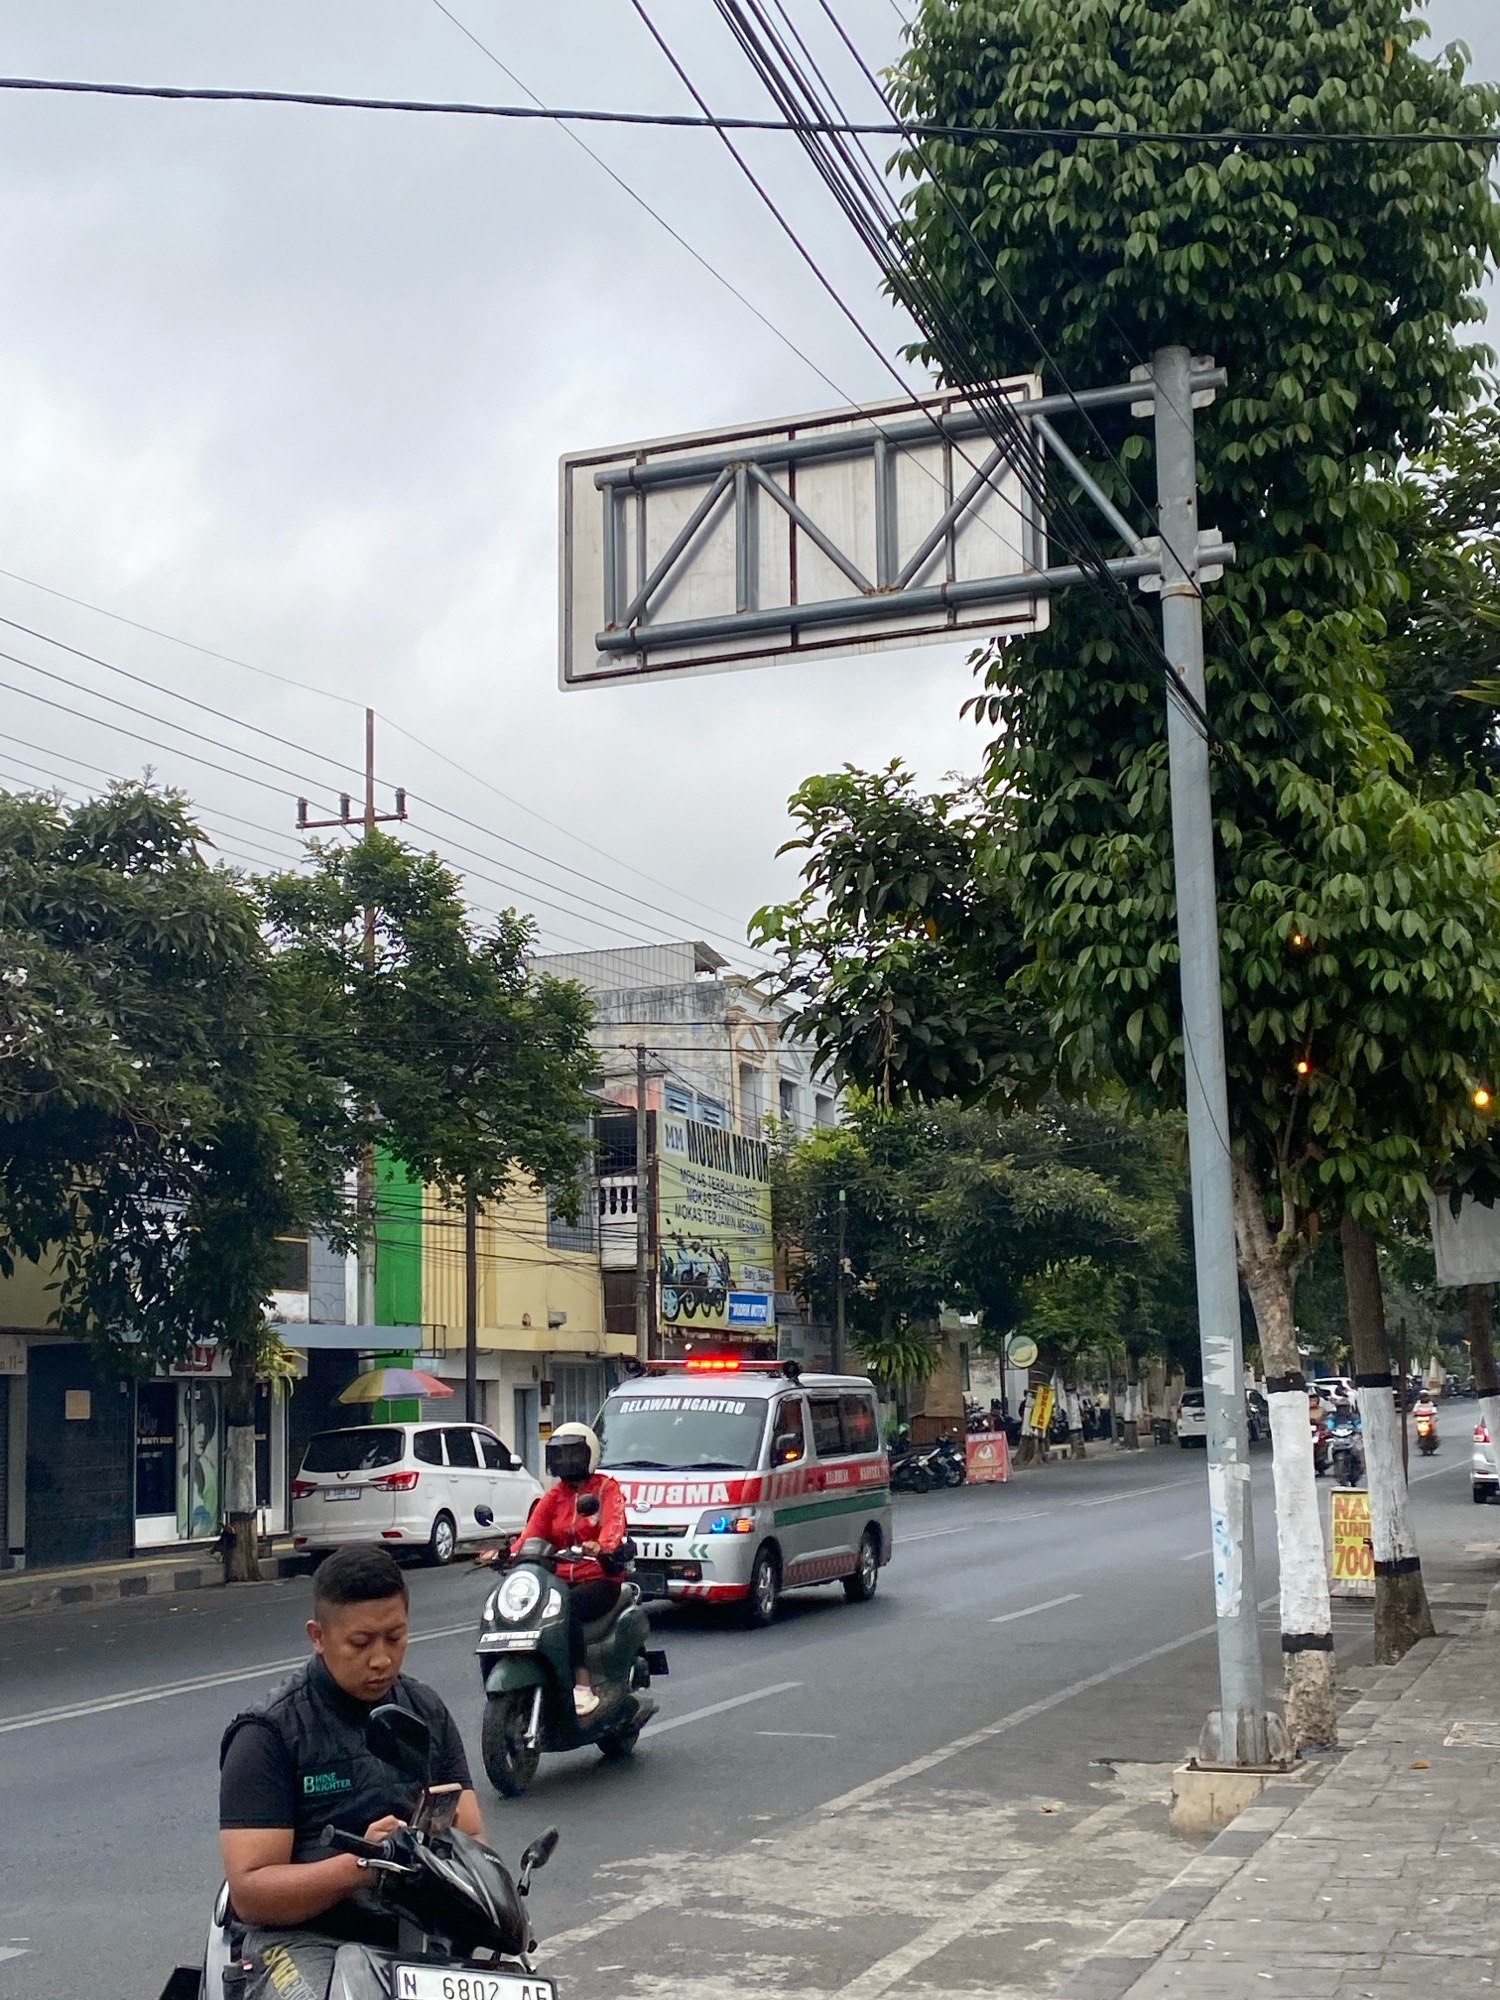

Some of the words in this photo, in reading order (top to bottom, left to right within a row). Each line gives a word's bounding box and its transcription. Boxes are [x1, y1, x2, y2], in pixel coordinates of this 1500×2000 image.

[664, 1123, 684, 1152] MM
[686, 1118, 733, 1175] MUDRIK
[732, 1133, 769, 1184] MOTOR
[687, 1187, 712, 1208] MOKAS
[675, 1203, 702, 1223] MOKAS
[619, 1397, 681, 1414] RELAWAN
[681, 1397, 746, 1416] NGANTRU
[1036, 1387, 1050, 1427] DURIAN
[404, 1972, 418, 1997] N
[442, 1976, 500, 2000] 6802
